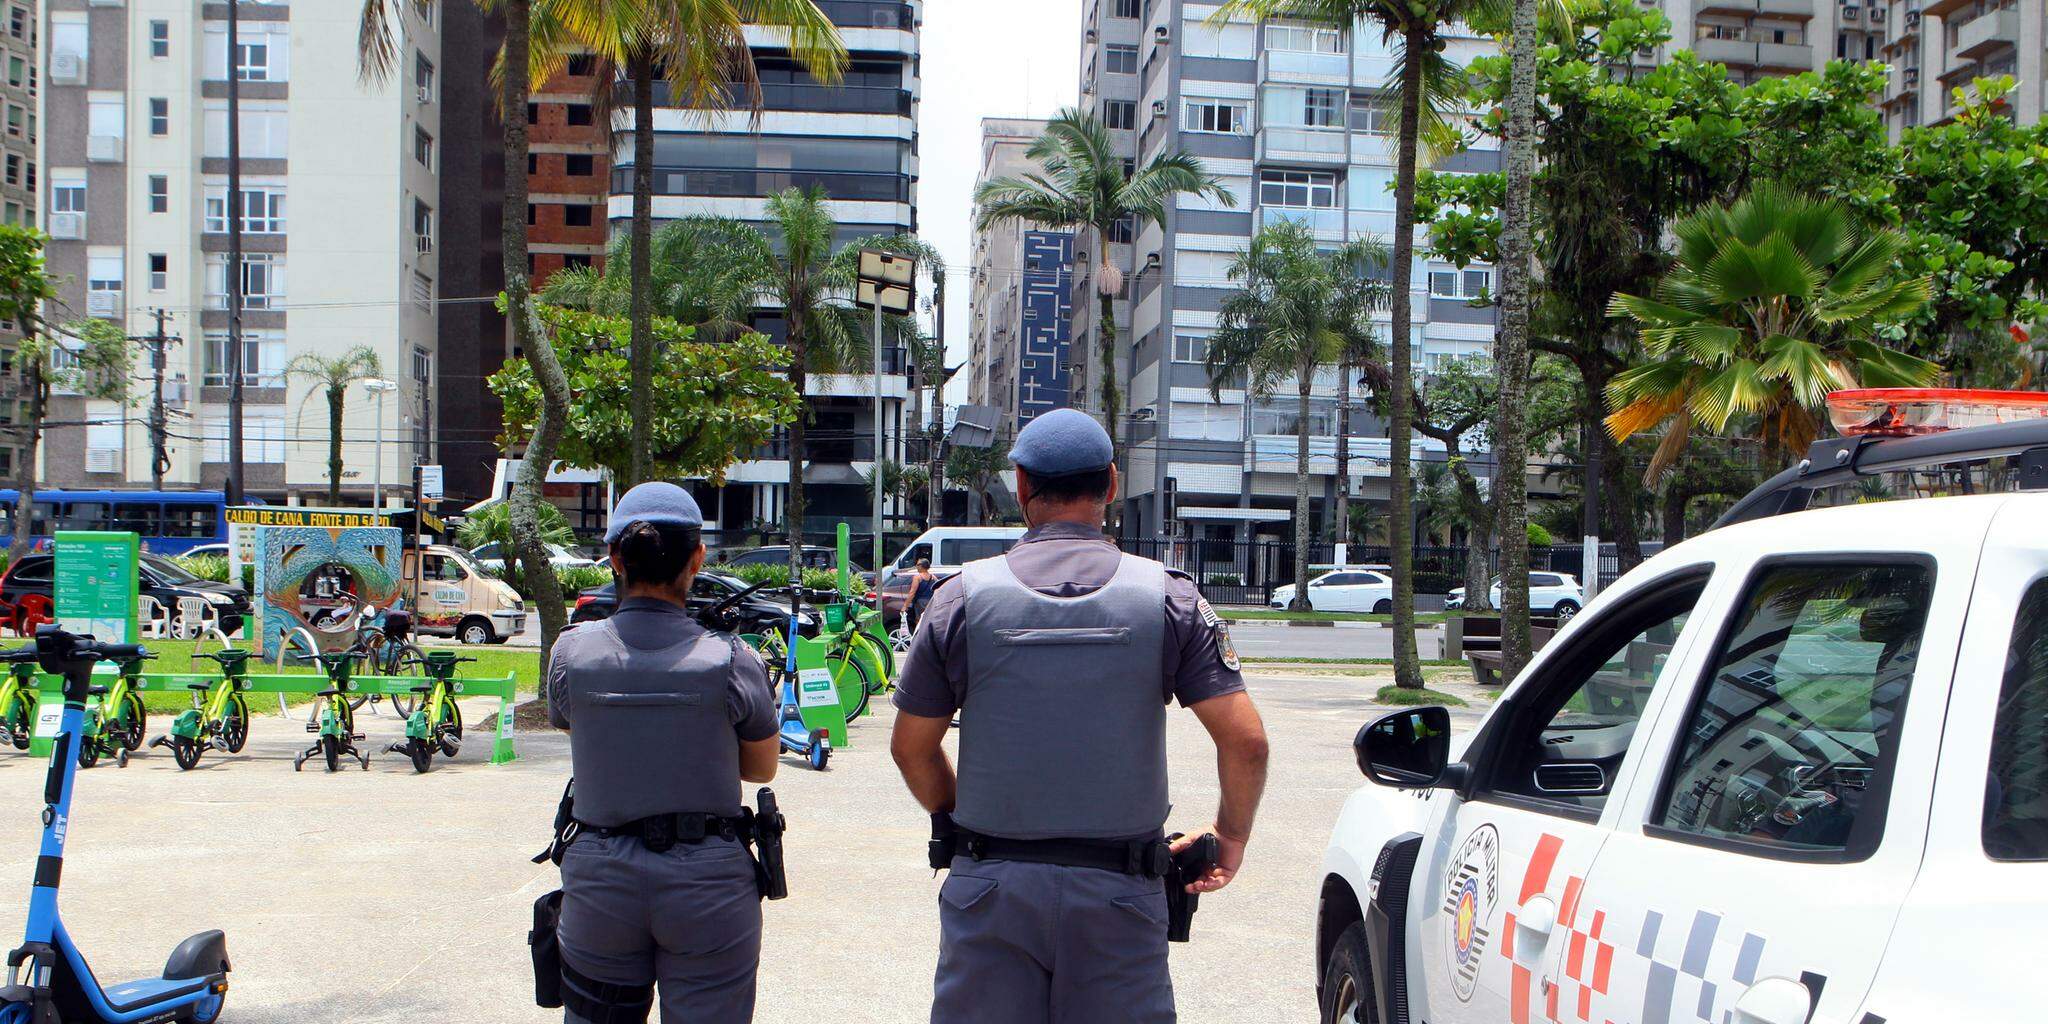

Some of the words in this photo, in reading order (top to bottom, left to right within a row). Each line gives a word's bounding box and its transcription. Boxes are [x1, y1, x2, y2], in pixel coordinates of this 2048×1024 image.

[225, 509, 257, 523] CALDO
[260, 510, 273, 524] DE
[276, 511, 303, 526] CANA
[310, 513, 341, 526] FONTE
[344, 514, 359, 527] DO
[54, 813, 67, 845] JET
[1484, 832, 1496, 907] MILITAR
